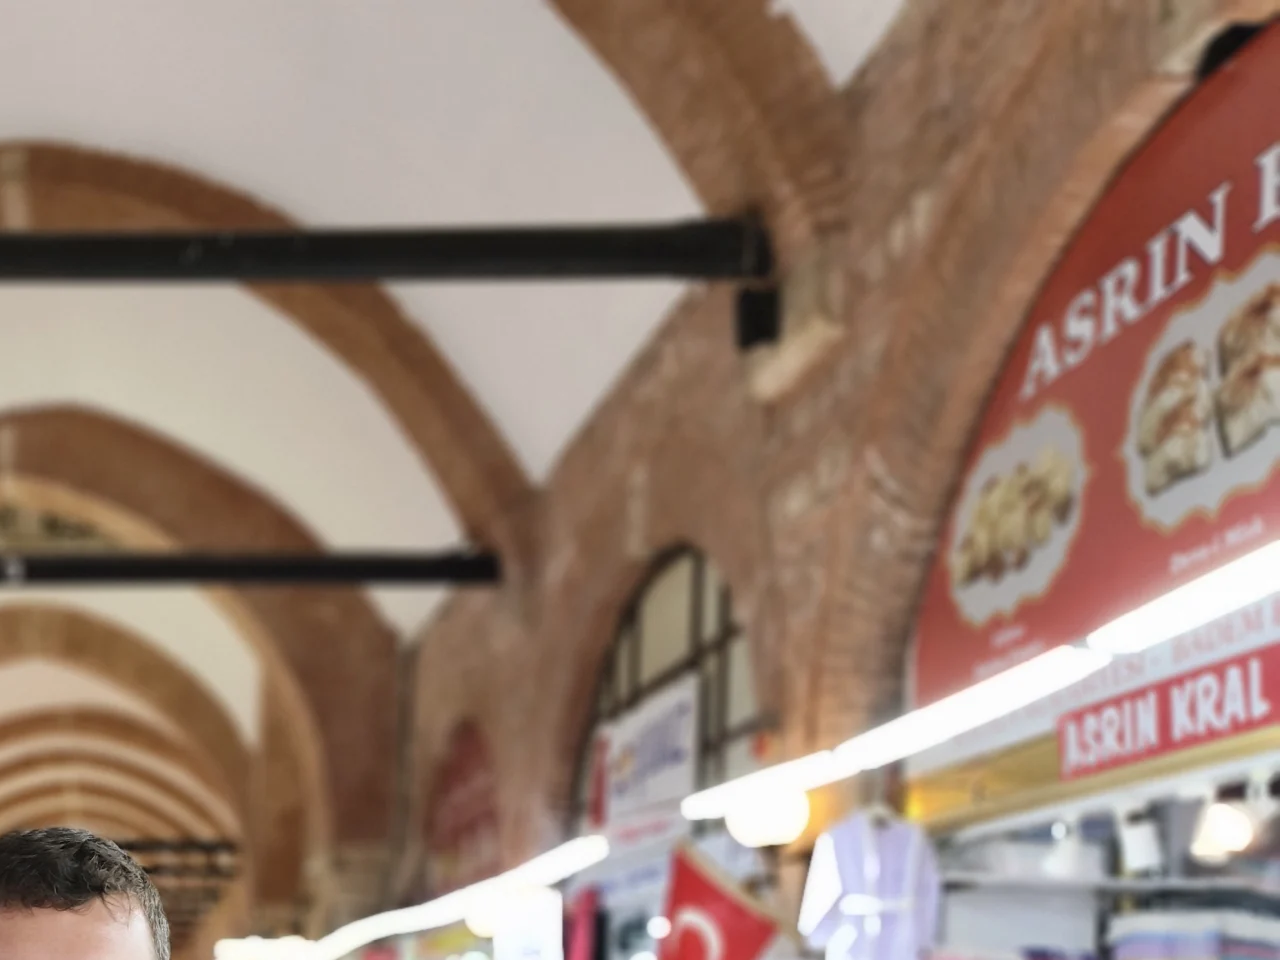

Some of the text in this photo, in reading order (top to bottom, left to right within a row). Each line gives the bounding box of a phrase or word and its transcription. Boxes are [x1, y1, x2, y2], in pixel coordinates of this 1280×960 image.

[1020, 182, 1232, 400] ASRIN
[1062, 691, 1158, 771] ASRIN
[1170, 658, 1270, 742] KRAL
